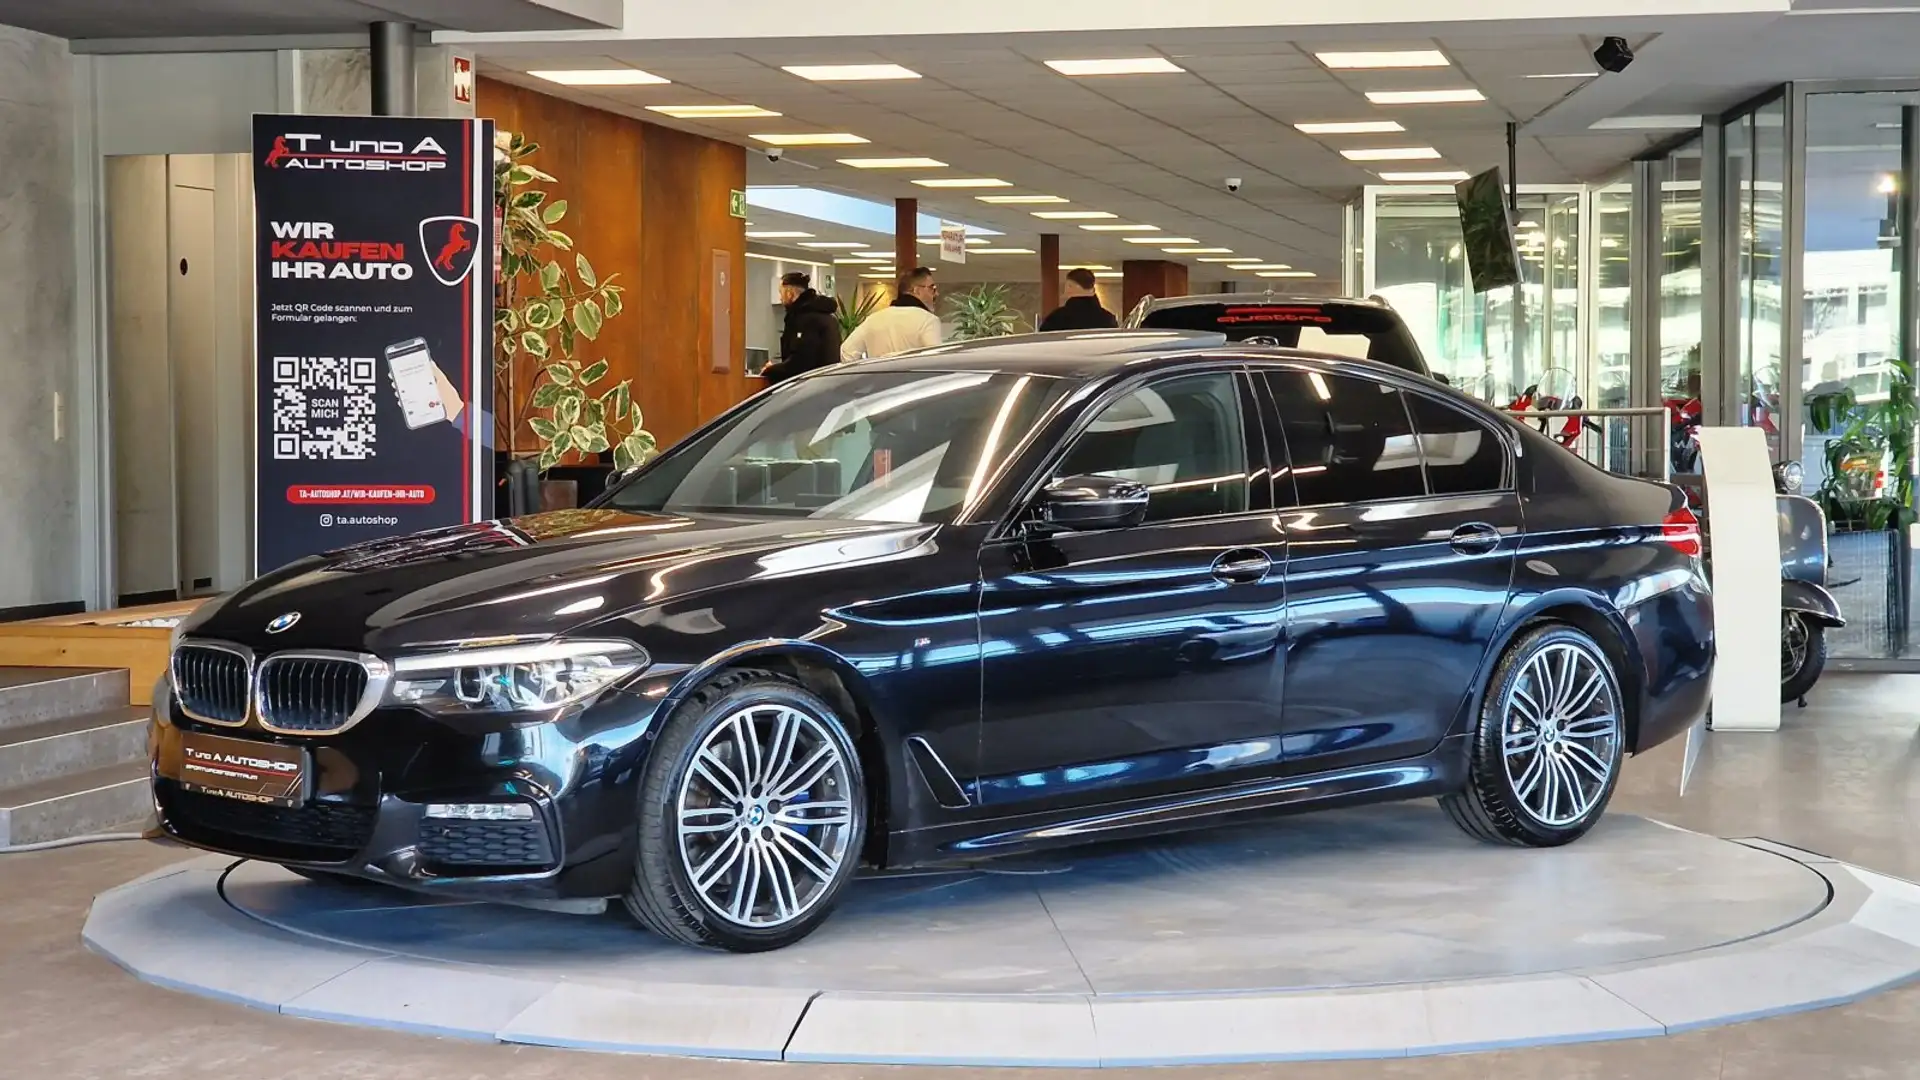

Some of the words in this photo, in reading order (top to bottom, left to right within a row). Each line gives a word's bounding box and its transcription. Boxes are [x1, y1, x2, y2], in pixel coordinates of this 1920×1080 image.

[284, 133, 321, 151] T
[411, 136, 447, 154] A
[284, 158, 447, 172] AUTOSHOP
[270, 221, 334, 239] WIR
[271, 241, 404, 260] KAUFEN
[271, 261, 325, 279] IHR
[328, 262, 413, 280] AUTO
[271, 303, 293, 312] Jetzt
[294, 303, 309, 313] QR
[310, 303, 333, 312] Code
[335, 304, 372, 312] scannen
[374, 304, 391, 313] und
[393, 305, 413, 313] zum
[271, 313, 311, 322] Formular
[1217, 314, 1332, 323] quattro
[311, 399, 339, 408] SCAN
[311, 409, 339, 419] MICH
[336, 515, 399, 526] ta.autoshop
[185, 747, 194, 756] T
[213, 753, 222, 762] A
[224, 755, 298, 772] AUTOSHOP
[225, 790, 274, 803] AUTOSHOP
